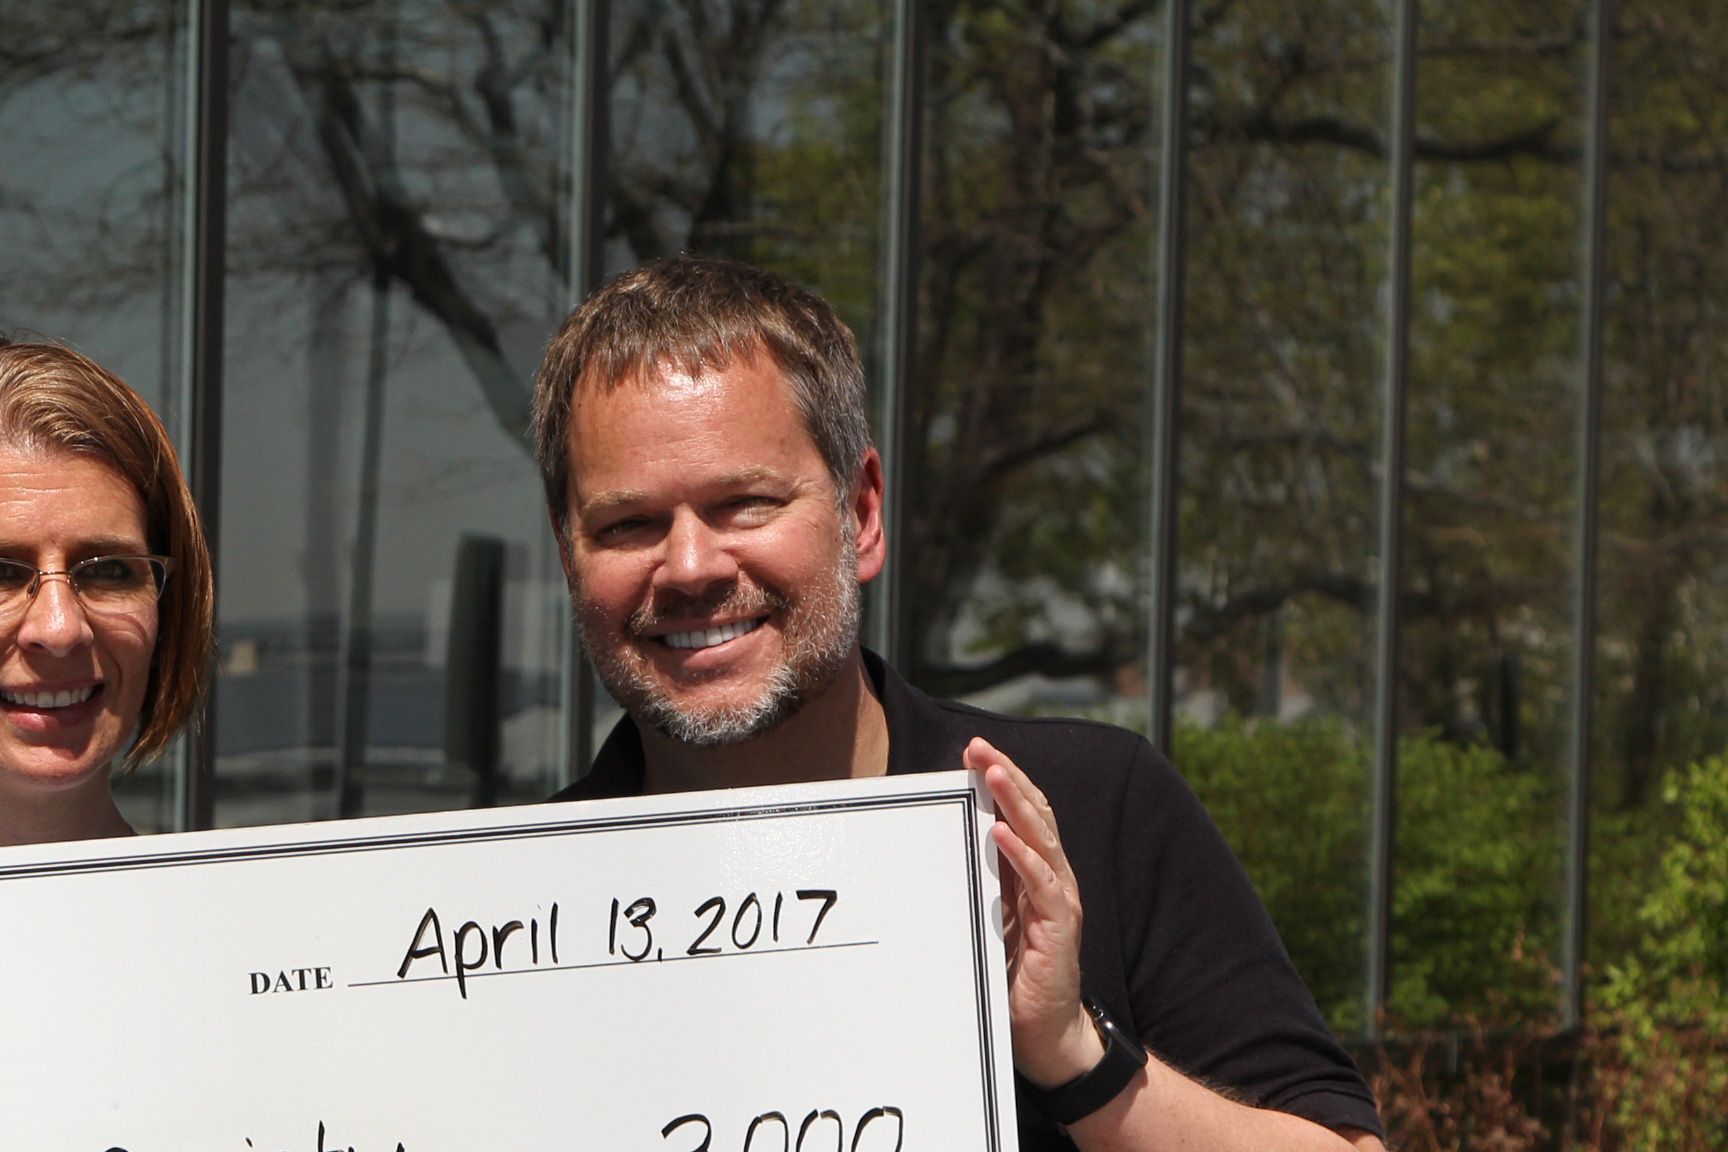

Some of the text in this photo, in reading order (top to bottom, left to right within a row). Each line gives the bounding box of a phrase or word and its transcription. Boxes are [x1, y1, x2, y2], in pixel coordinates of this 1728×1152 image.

[398, 890, 837, 999] April 13, 2017
[249, 967, 333, 995] DATE
